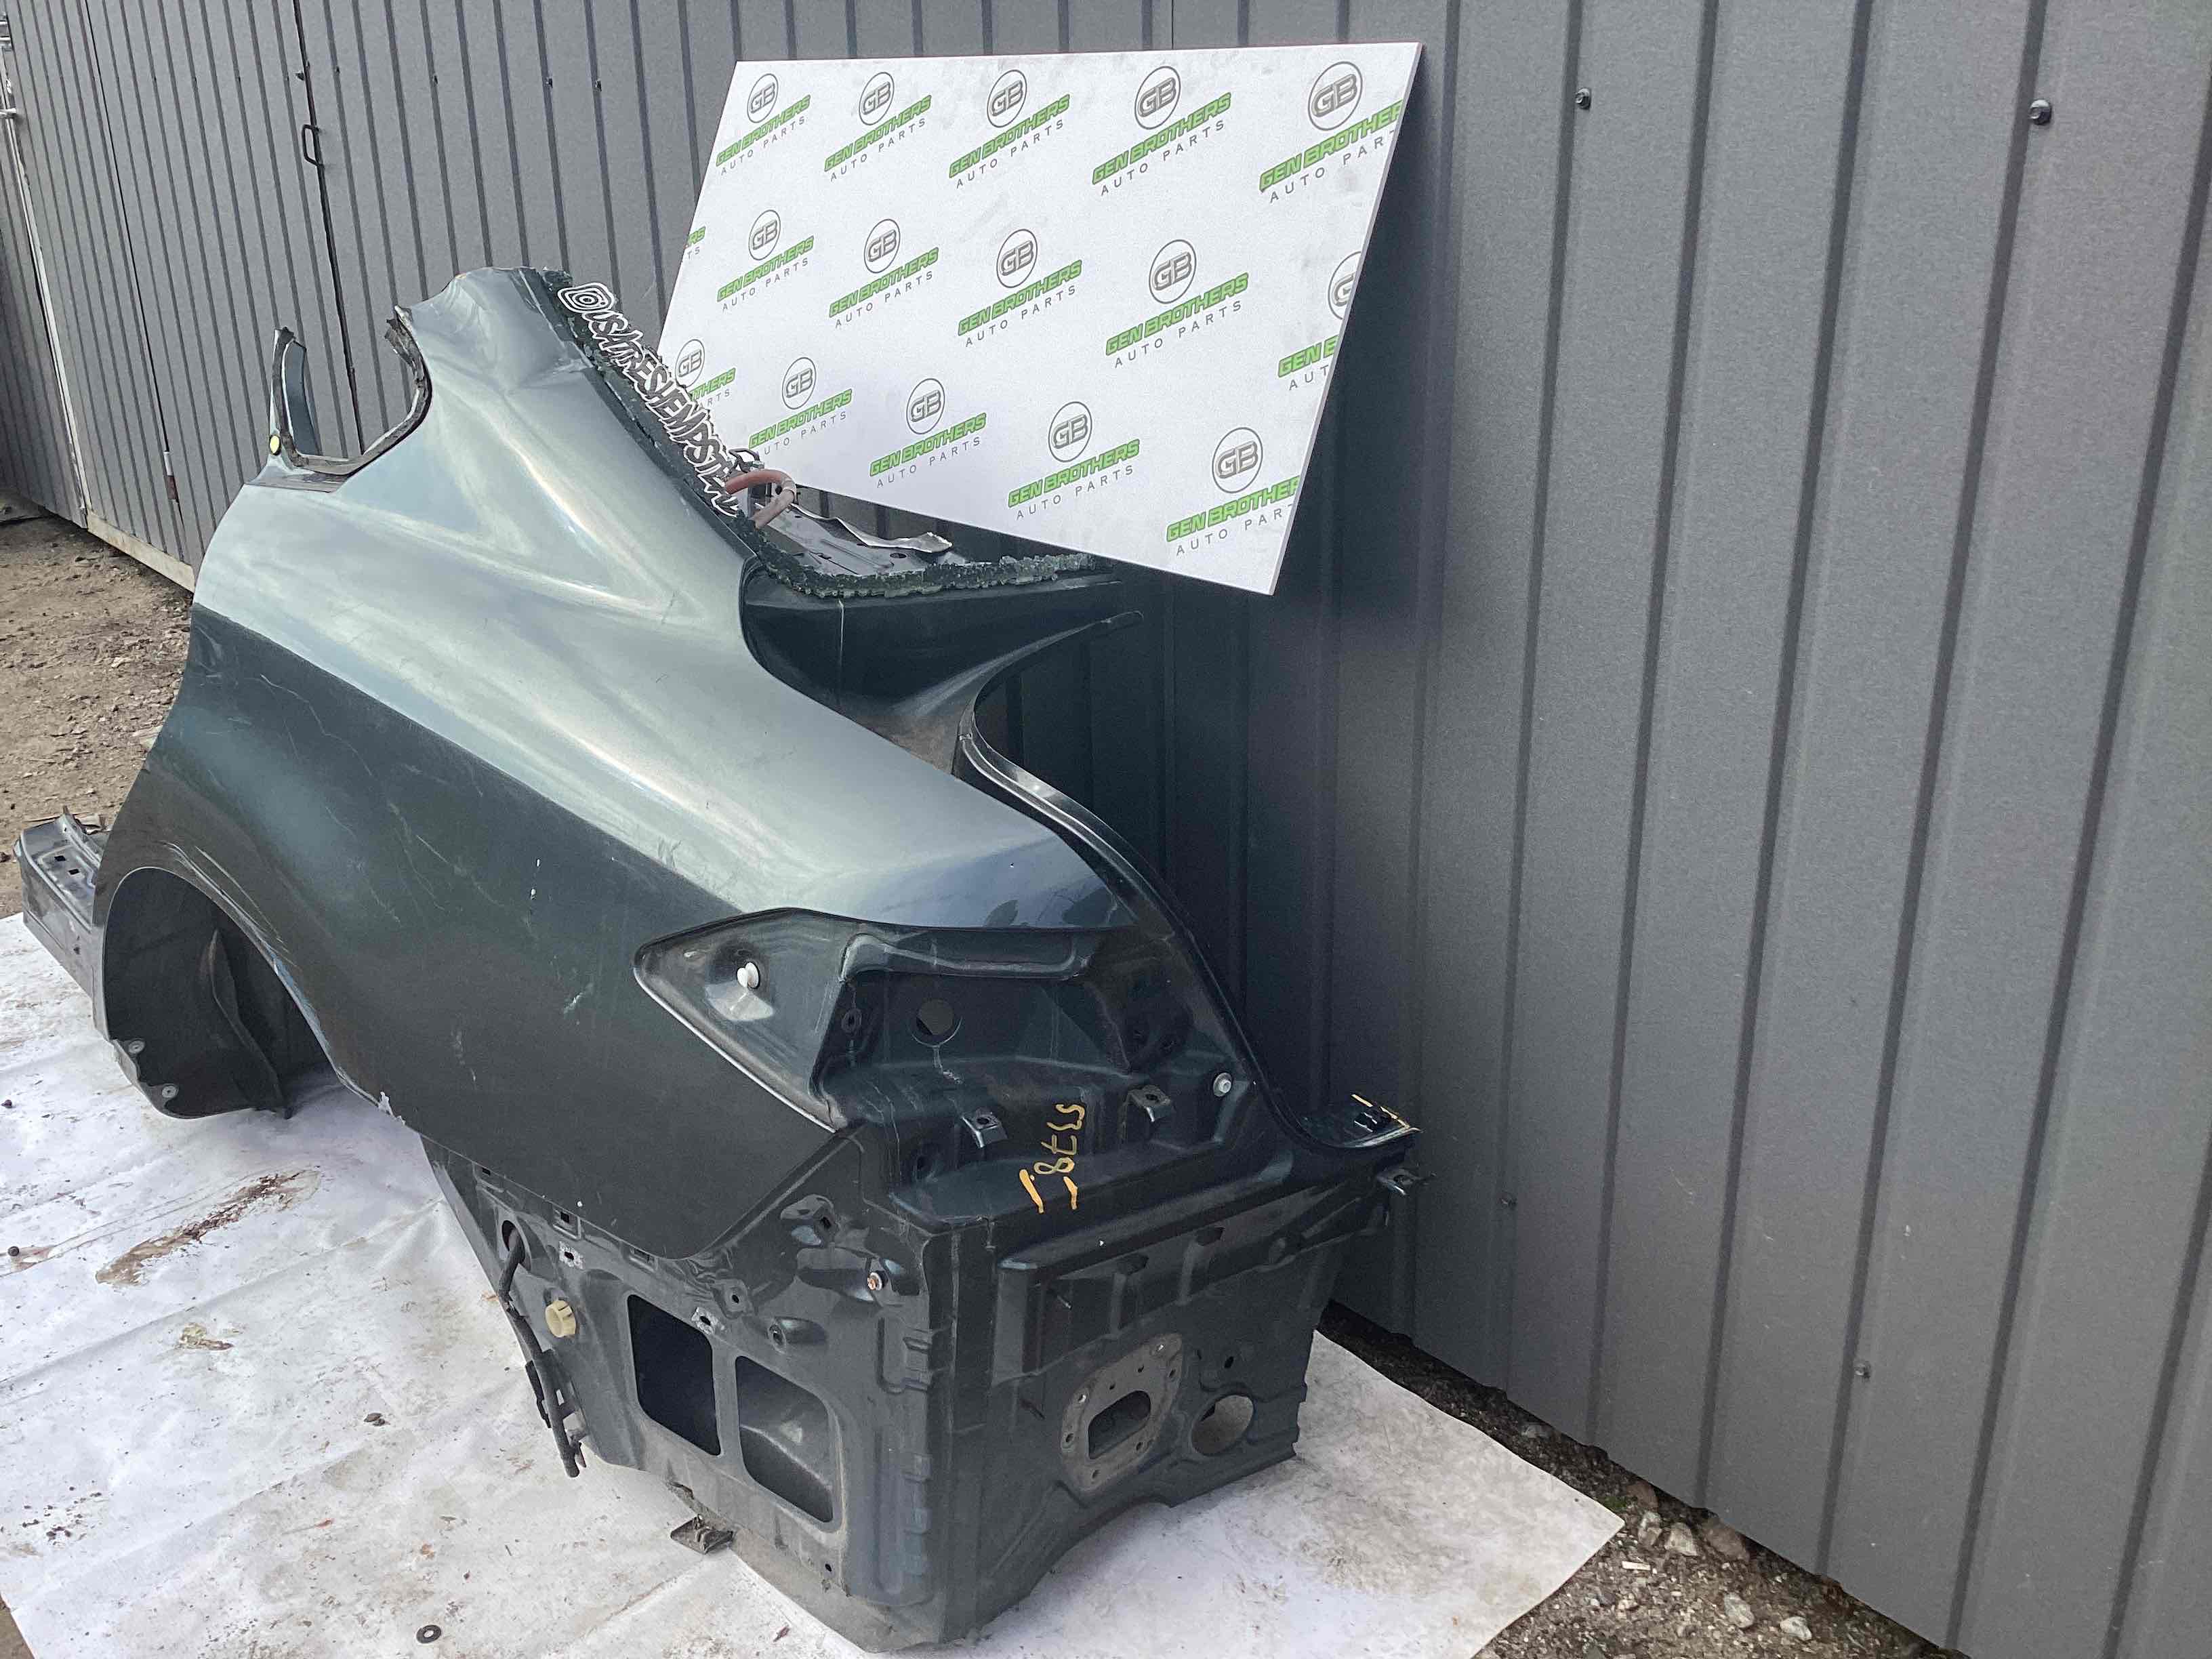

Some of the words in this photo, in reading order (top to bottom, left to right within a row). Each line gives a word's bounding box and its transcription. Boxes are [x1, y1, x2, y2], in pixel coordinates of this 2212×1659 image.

[750, 82, 776, 114] GB
[863, 81, 891, 115] GB
[991, 80, 1023, 117] GB
[1138, 78, 1176, 118] GB
[1313, 74, 1357, 118] GB
[716, 142, 743, 167] GEN
[742, 95, 811, 150] BROTHERS
[721, 150, 754, 175] AUTO
[764, 117, 805, 148] PARTS
[824, 141, 854, 171] GEN
[854, 95, 931, 152] BROTHERS
[831, 152, 867, 182] AUTO
[879, 118, 926, 152] PARTS
[949, 146, 980, 178] GEN
[981, 94, 1069, 159] BROTHERS
[956, 158, 998, 188] AUTO
[1010, 120, 1064, 157] PARTS
[1092, 150, 1128, 184] GEN
[1130, 92, 1231, 163] BROTHERS
[1101, 163, 1148, 195] AUTO
[1163, 120, 1225, 161] PARTS
[1260, 153, 1302, 191] GEN
[1270, 167, 1325, 203] AUTO
[752, 221, 777, 251] GB
[867, 230, 897, 262] GB
[1002, 241, 1033, 276] GB
[717, 279, 744, 302] GEN
[743, 236, 814, 285] BROTHERS
[722, 287, 756, 312] AUTO
[766, 258, 808, 287] PARTS
[829, 287, 859, 318] GEN
[859, 247, 939, 302] BROTHERS
[1153, 253, 1191, 291] GB
[836, 302, 873, 327] AUTO
[884, 271, 933, 302] PARTS
[958, 304, 991, 335] GEN
[992, 260, 1082, 319] BROTHERS
[966, 321, 1008, 347] AUTO
[1021, 285, 1076, 319] PARTS
[1106, 324, 1143, 355] GEN
[1145, 273, 1248, 338] BROTHERS
[1115, 339, 1163, 367] AUTO
[1179, 302, 1242, 337] PARTS
[1278, 342, 1322, 377] GEN
[679, 350, 702, 375] GB
[786, 368, 813, 397] GB
[749, 426, 777, 449] GEN
[776, 389, 852, 439] BROTHERS
[910, 390, 941, 422] GB
[1053, 414, 1088, 449] GB
[759, 438, 790, 455] UTO
[801, 412, 846, 438] PARTS
[869, 449, 900, 476] GEN
[901, 412, 986, 465] BROTHERS
[877, 466, 916, 488] AUTO
[929, 437, 981, 466] PARTS
[1008, 476, 1043, 507] GEN
[1044, 439, 1139, 492] BROTHERS
[1217, 442, 1258, 478] GB
[1017, 495, 1061, 520] AUTO
[1076, 466, 1133, 497] PARTS
[1166, 511, 1205, 542] GEN
[1176, 529, 1228, 556] AUTO
